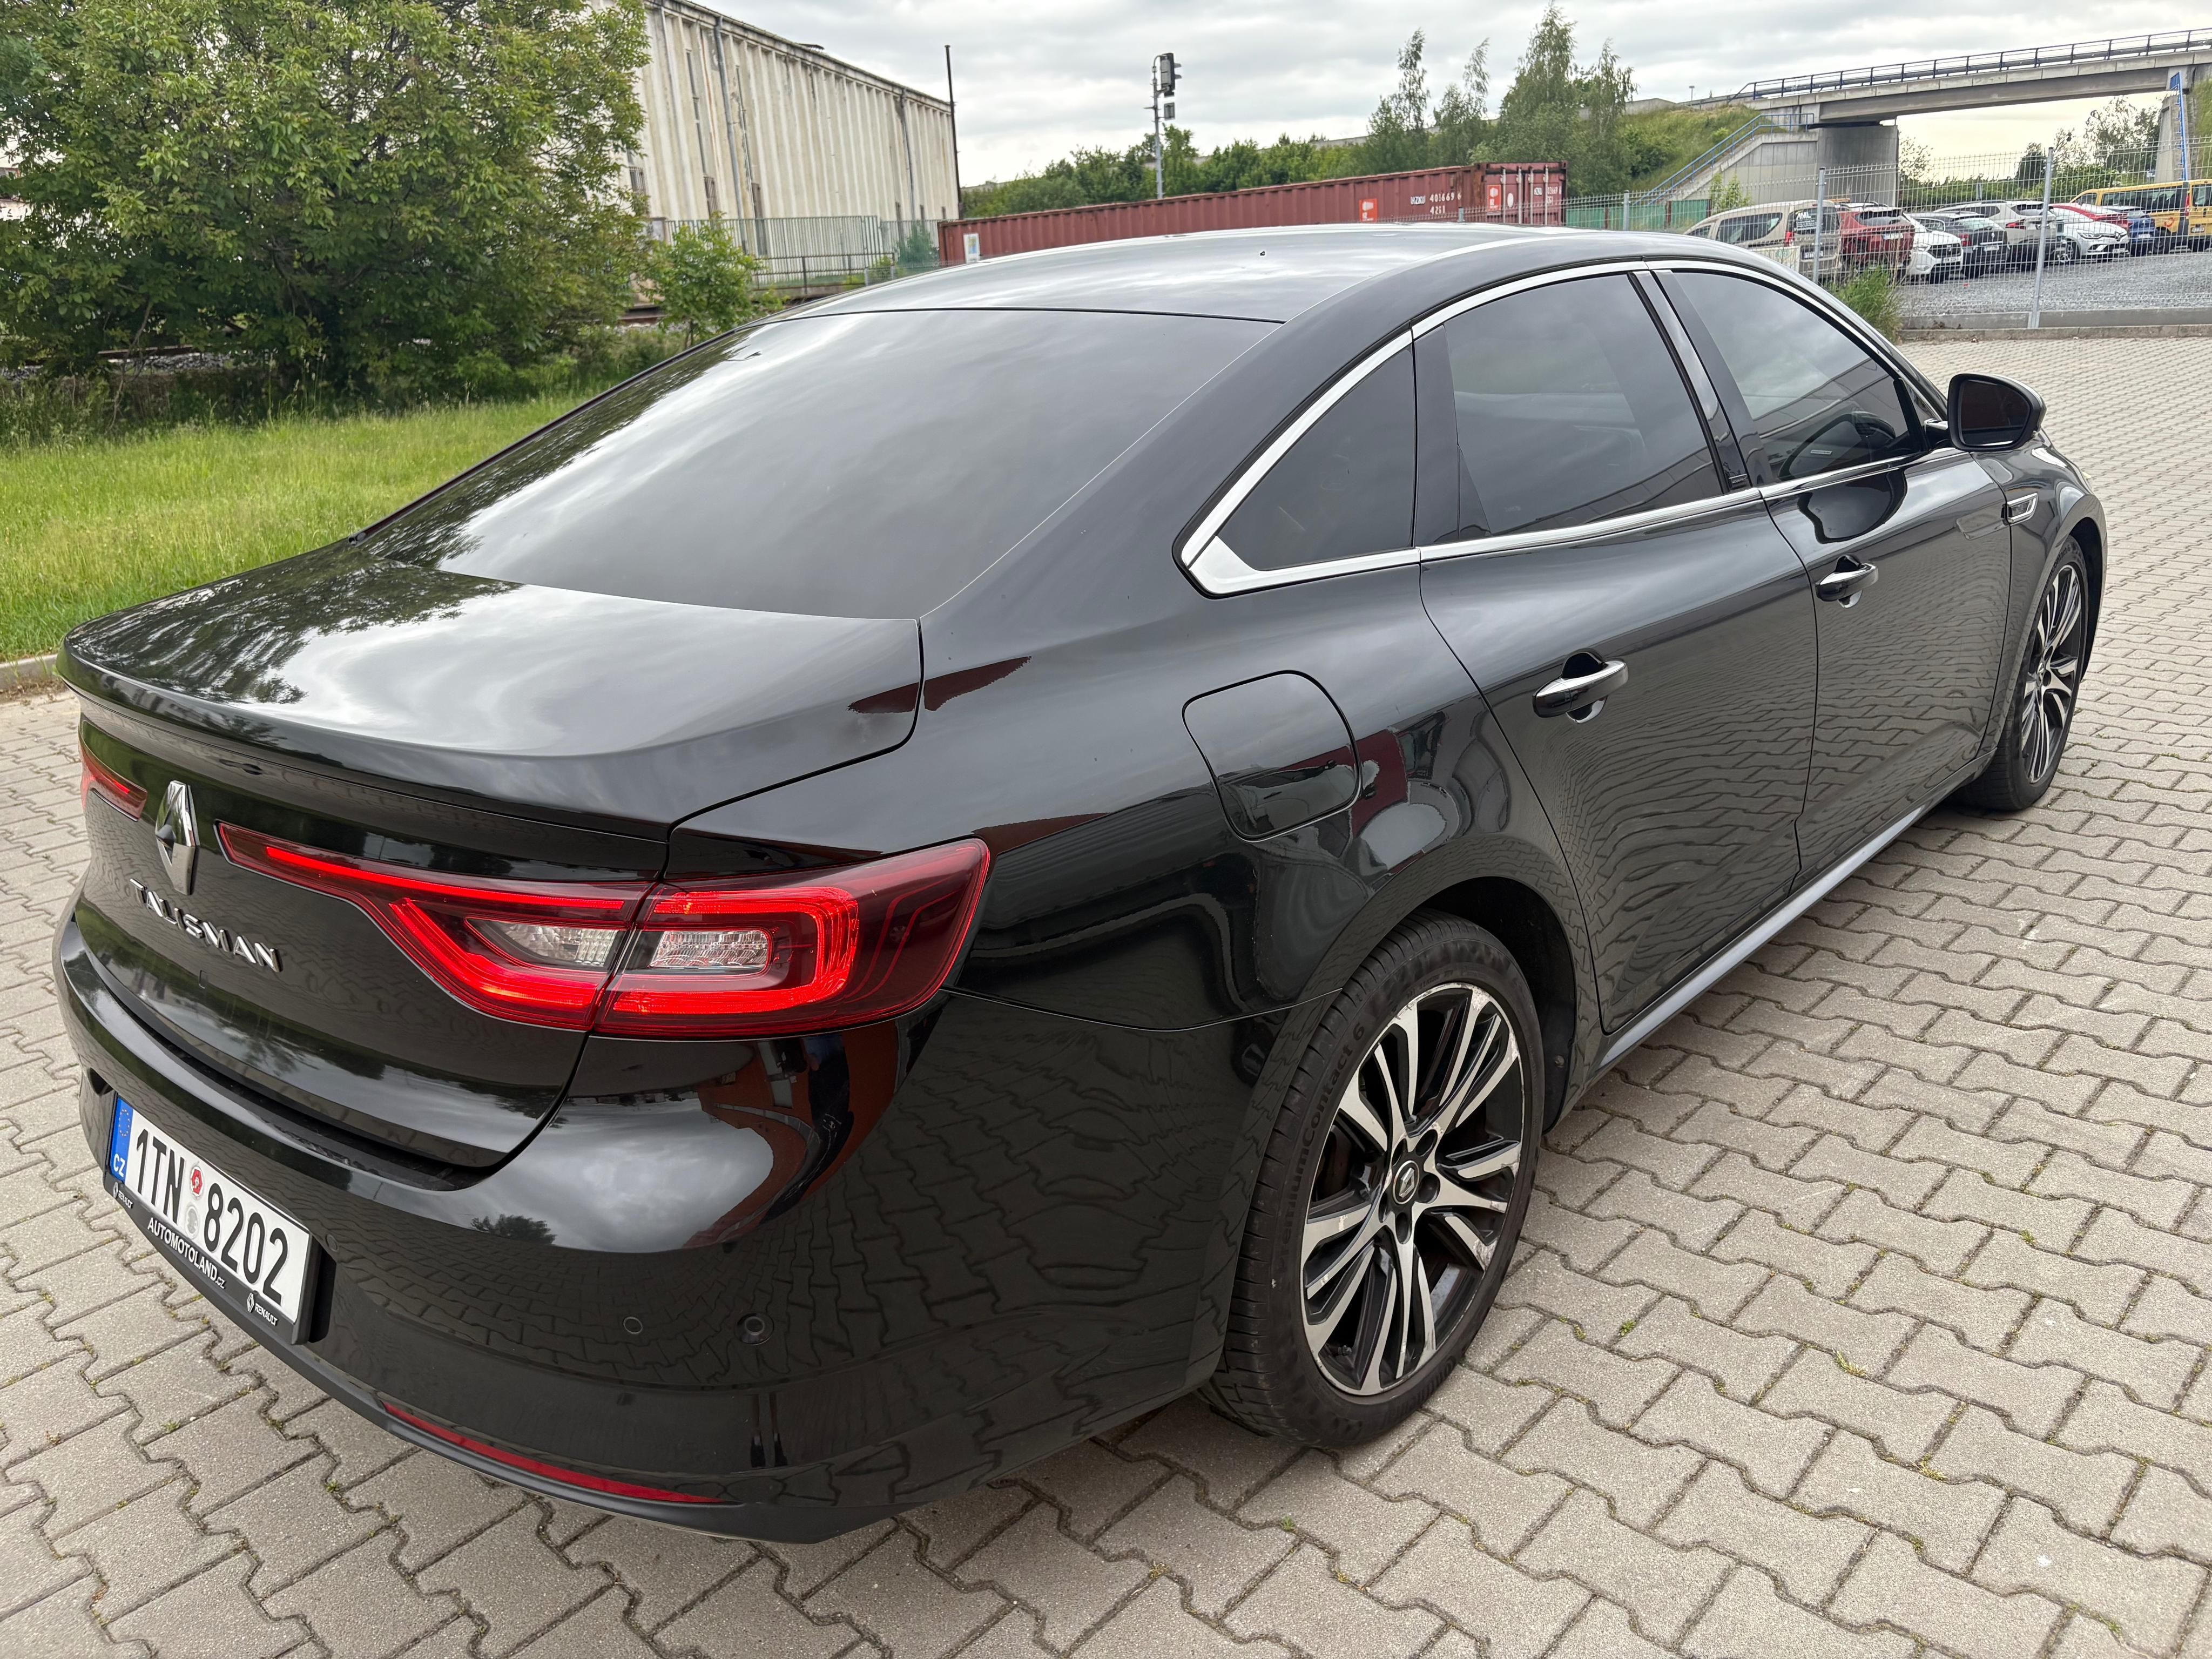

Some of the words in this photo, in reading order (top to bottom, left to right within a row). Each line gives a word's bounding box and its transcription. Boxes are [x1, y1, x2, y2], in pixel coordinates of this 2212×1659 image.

[130, 878, 283, 972] TALISMAN
[1353, 1023, 1365, 1041] 6
[113, 1153, 126, 1178] CZ
[136, 1129, 185, 1224] 1TN
[204, 1183, 288, 1306] 8202
[255, 1303, 278, 1326] RENAULT
